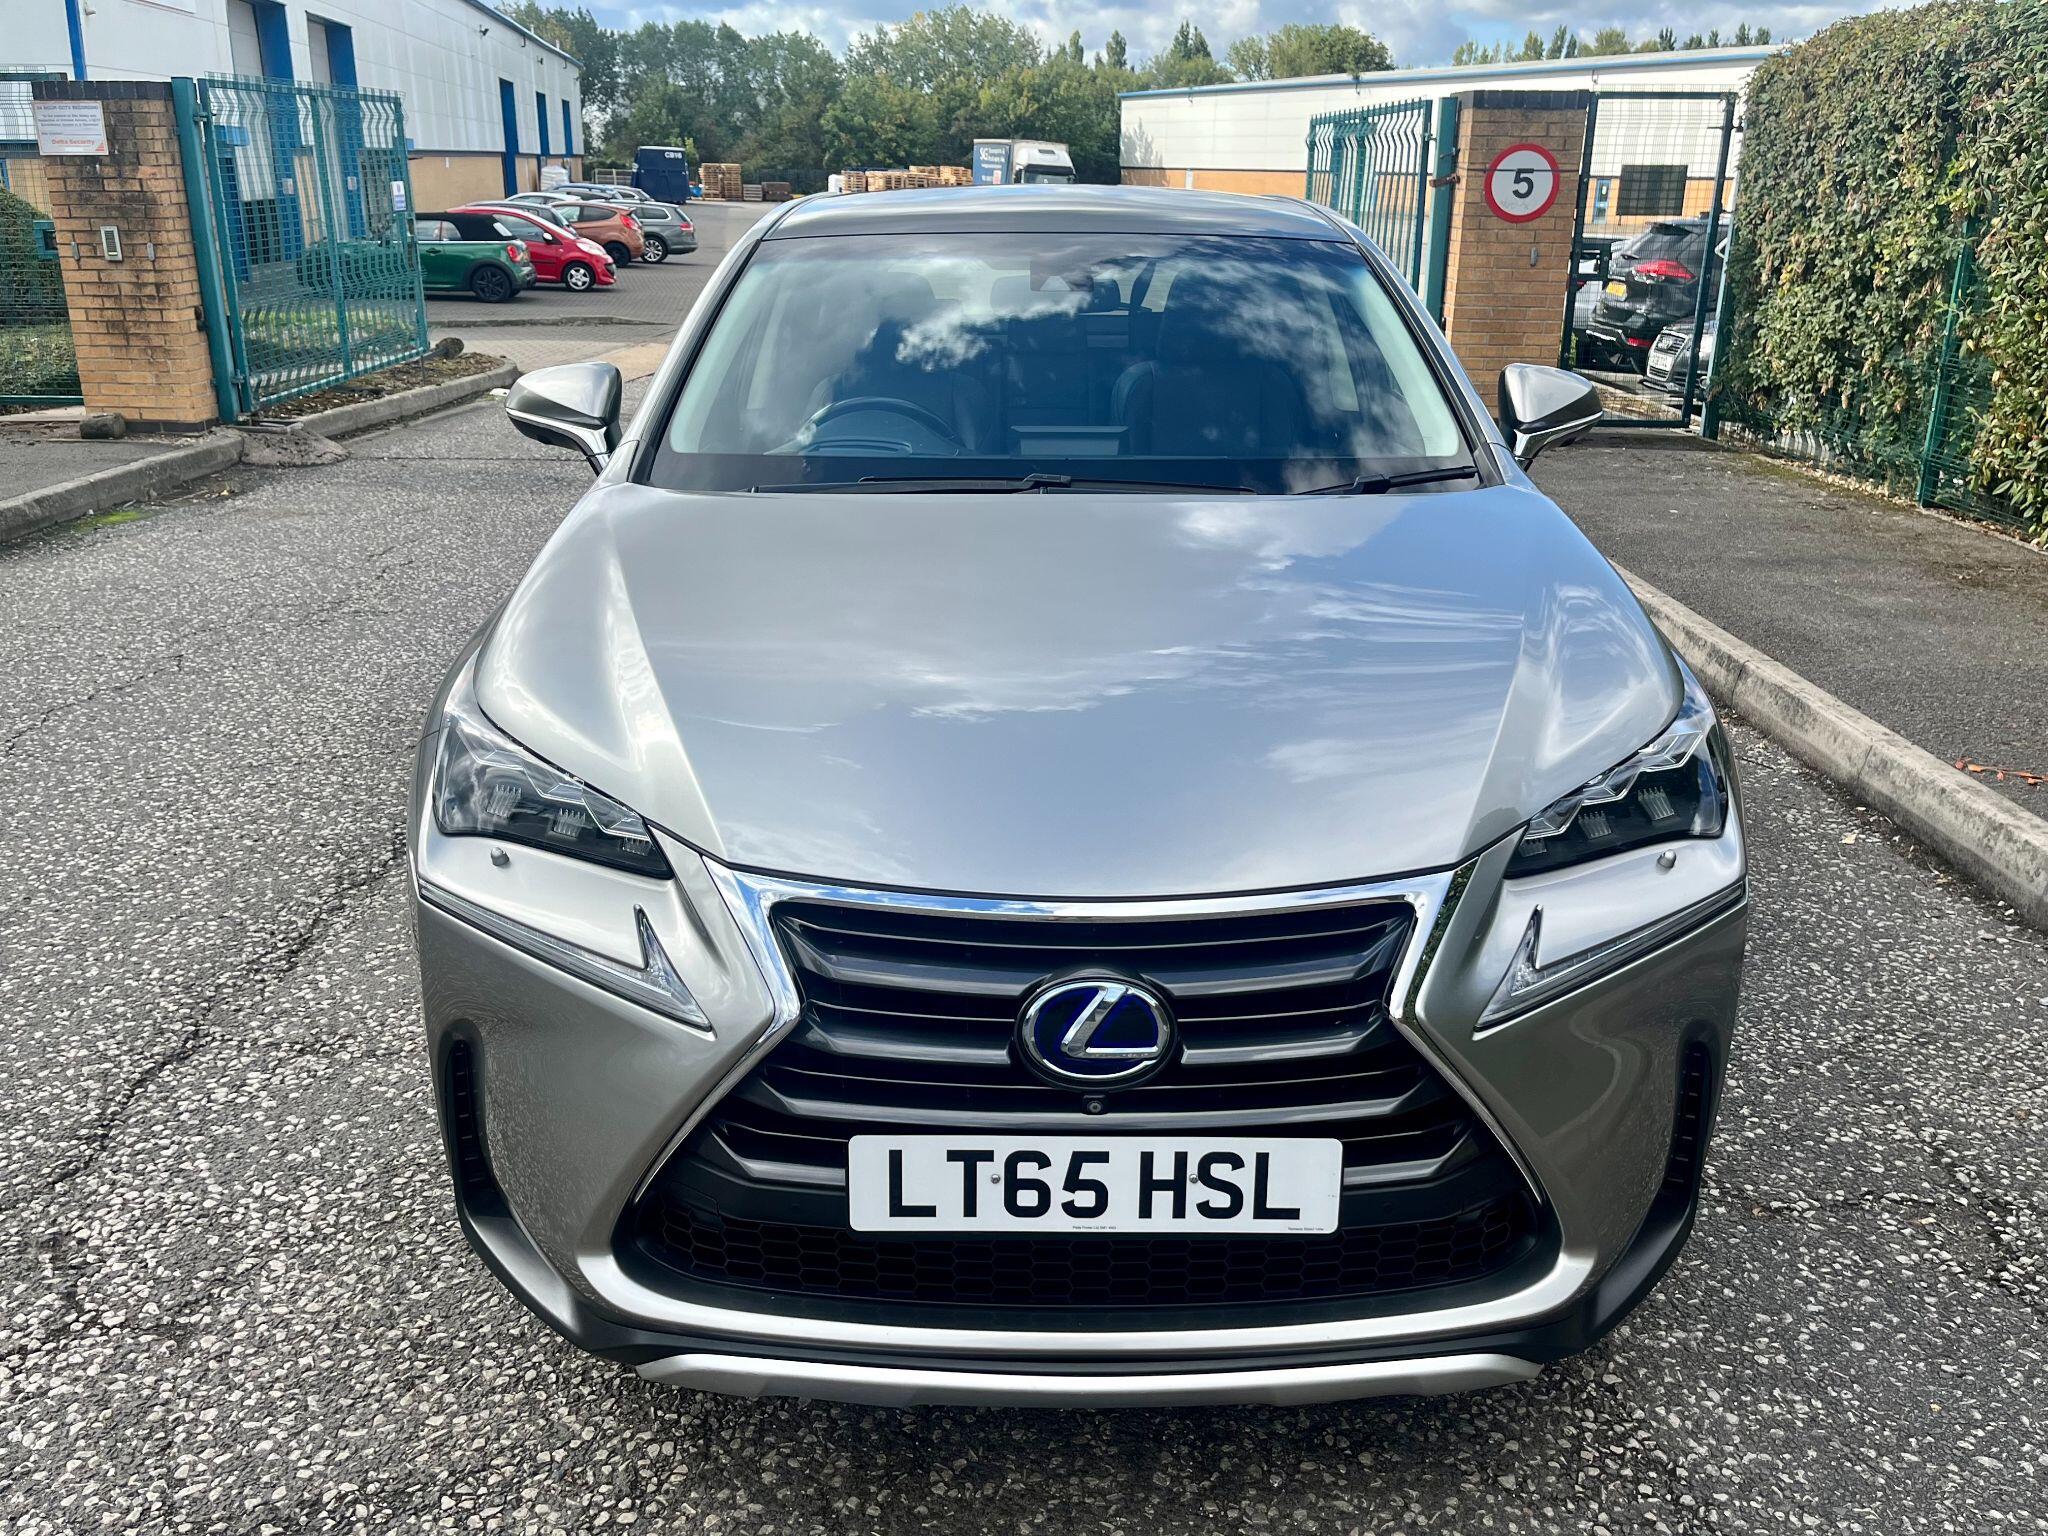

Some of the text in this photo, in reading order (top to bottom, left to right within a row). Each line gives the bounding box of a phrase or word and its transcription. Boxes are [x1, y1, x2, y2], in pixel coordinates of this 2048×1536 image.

[69, 138, 95, 146] Security
[1512, 168, 1534, 198] 5
[888, 1149, 1301, 1220] LT65 HSL
